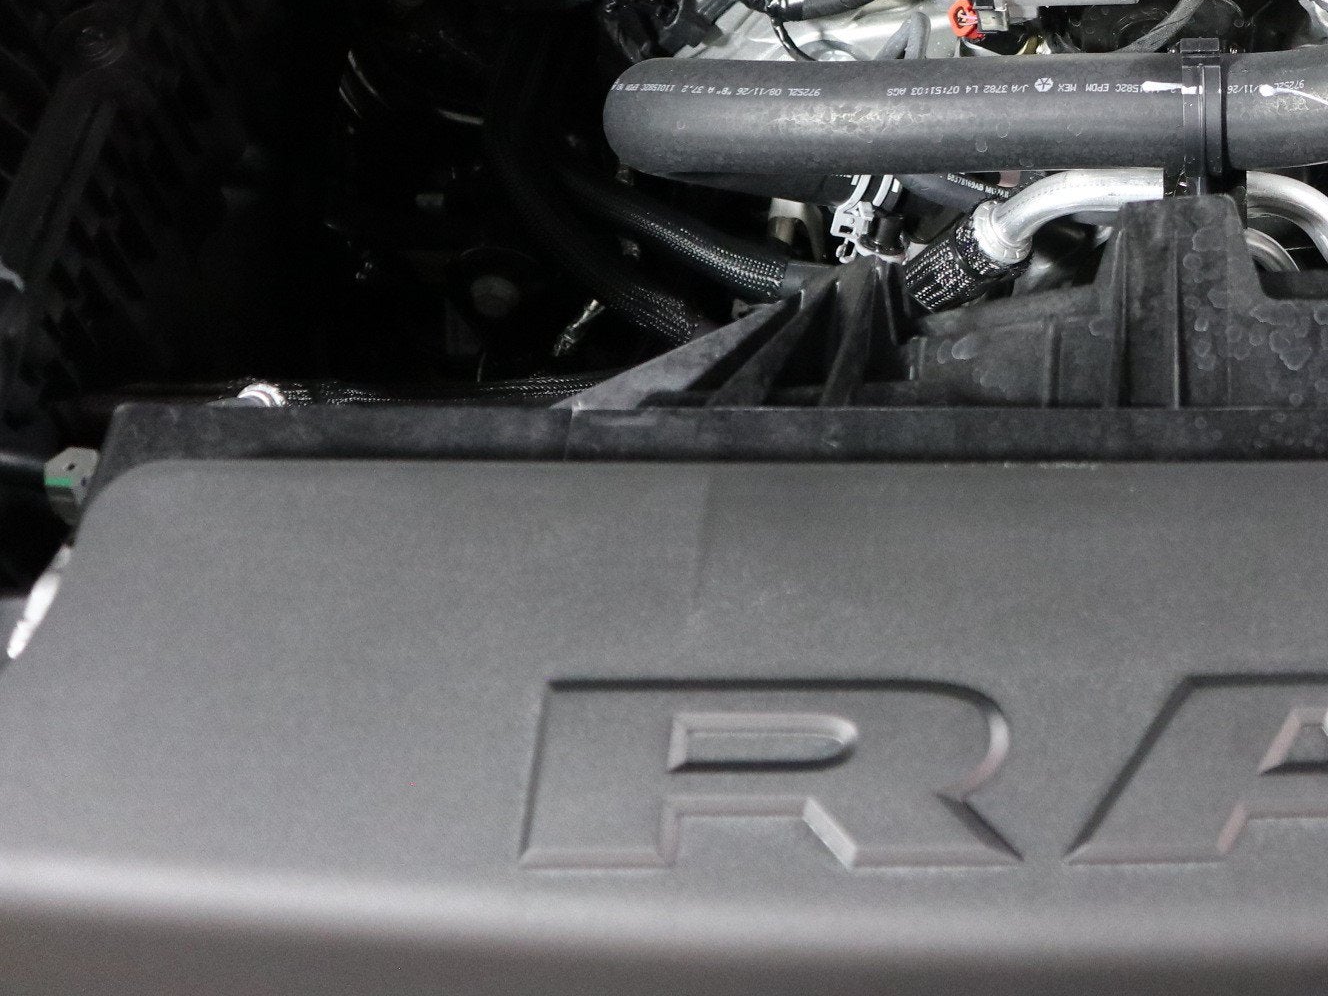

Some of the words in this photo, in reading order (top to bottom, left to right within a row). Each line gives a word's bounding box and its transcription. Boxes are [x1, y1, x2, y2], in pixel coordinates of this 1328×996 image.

[681, 85, 704, 93] 37.2
[736, 87, 782, 96] 08/11/26
[788, 87, 821, 97] 97252L
[886, 87, 907, 96] AGS
[911, 85, 960, 96] 07:51:03
[965, 85, 979, 94] L4
[982, 84, 1009, 93] 3782
[1011, 84, 1029, 93] J/A
[1058, 83, 1077, 92] MEX
[1085, 83, 1110, 92] EPDM
